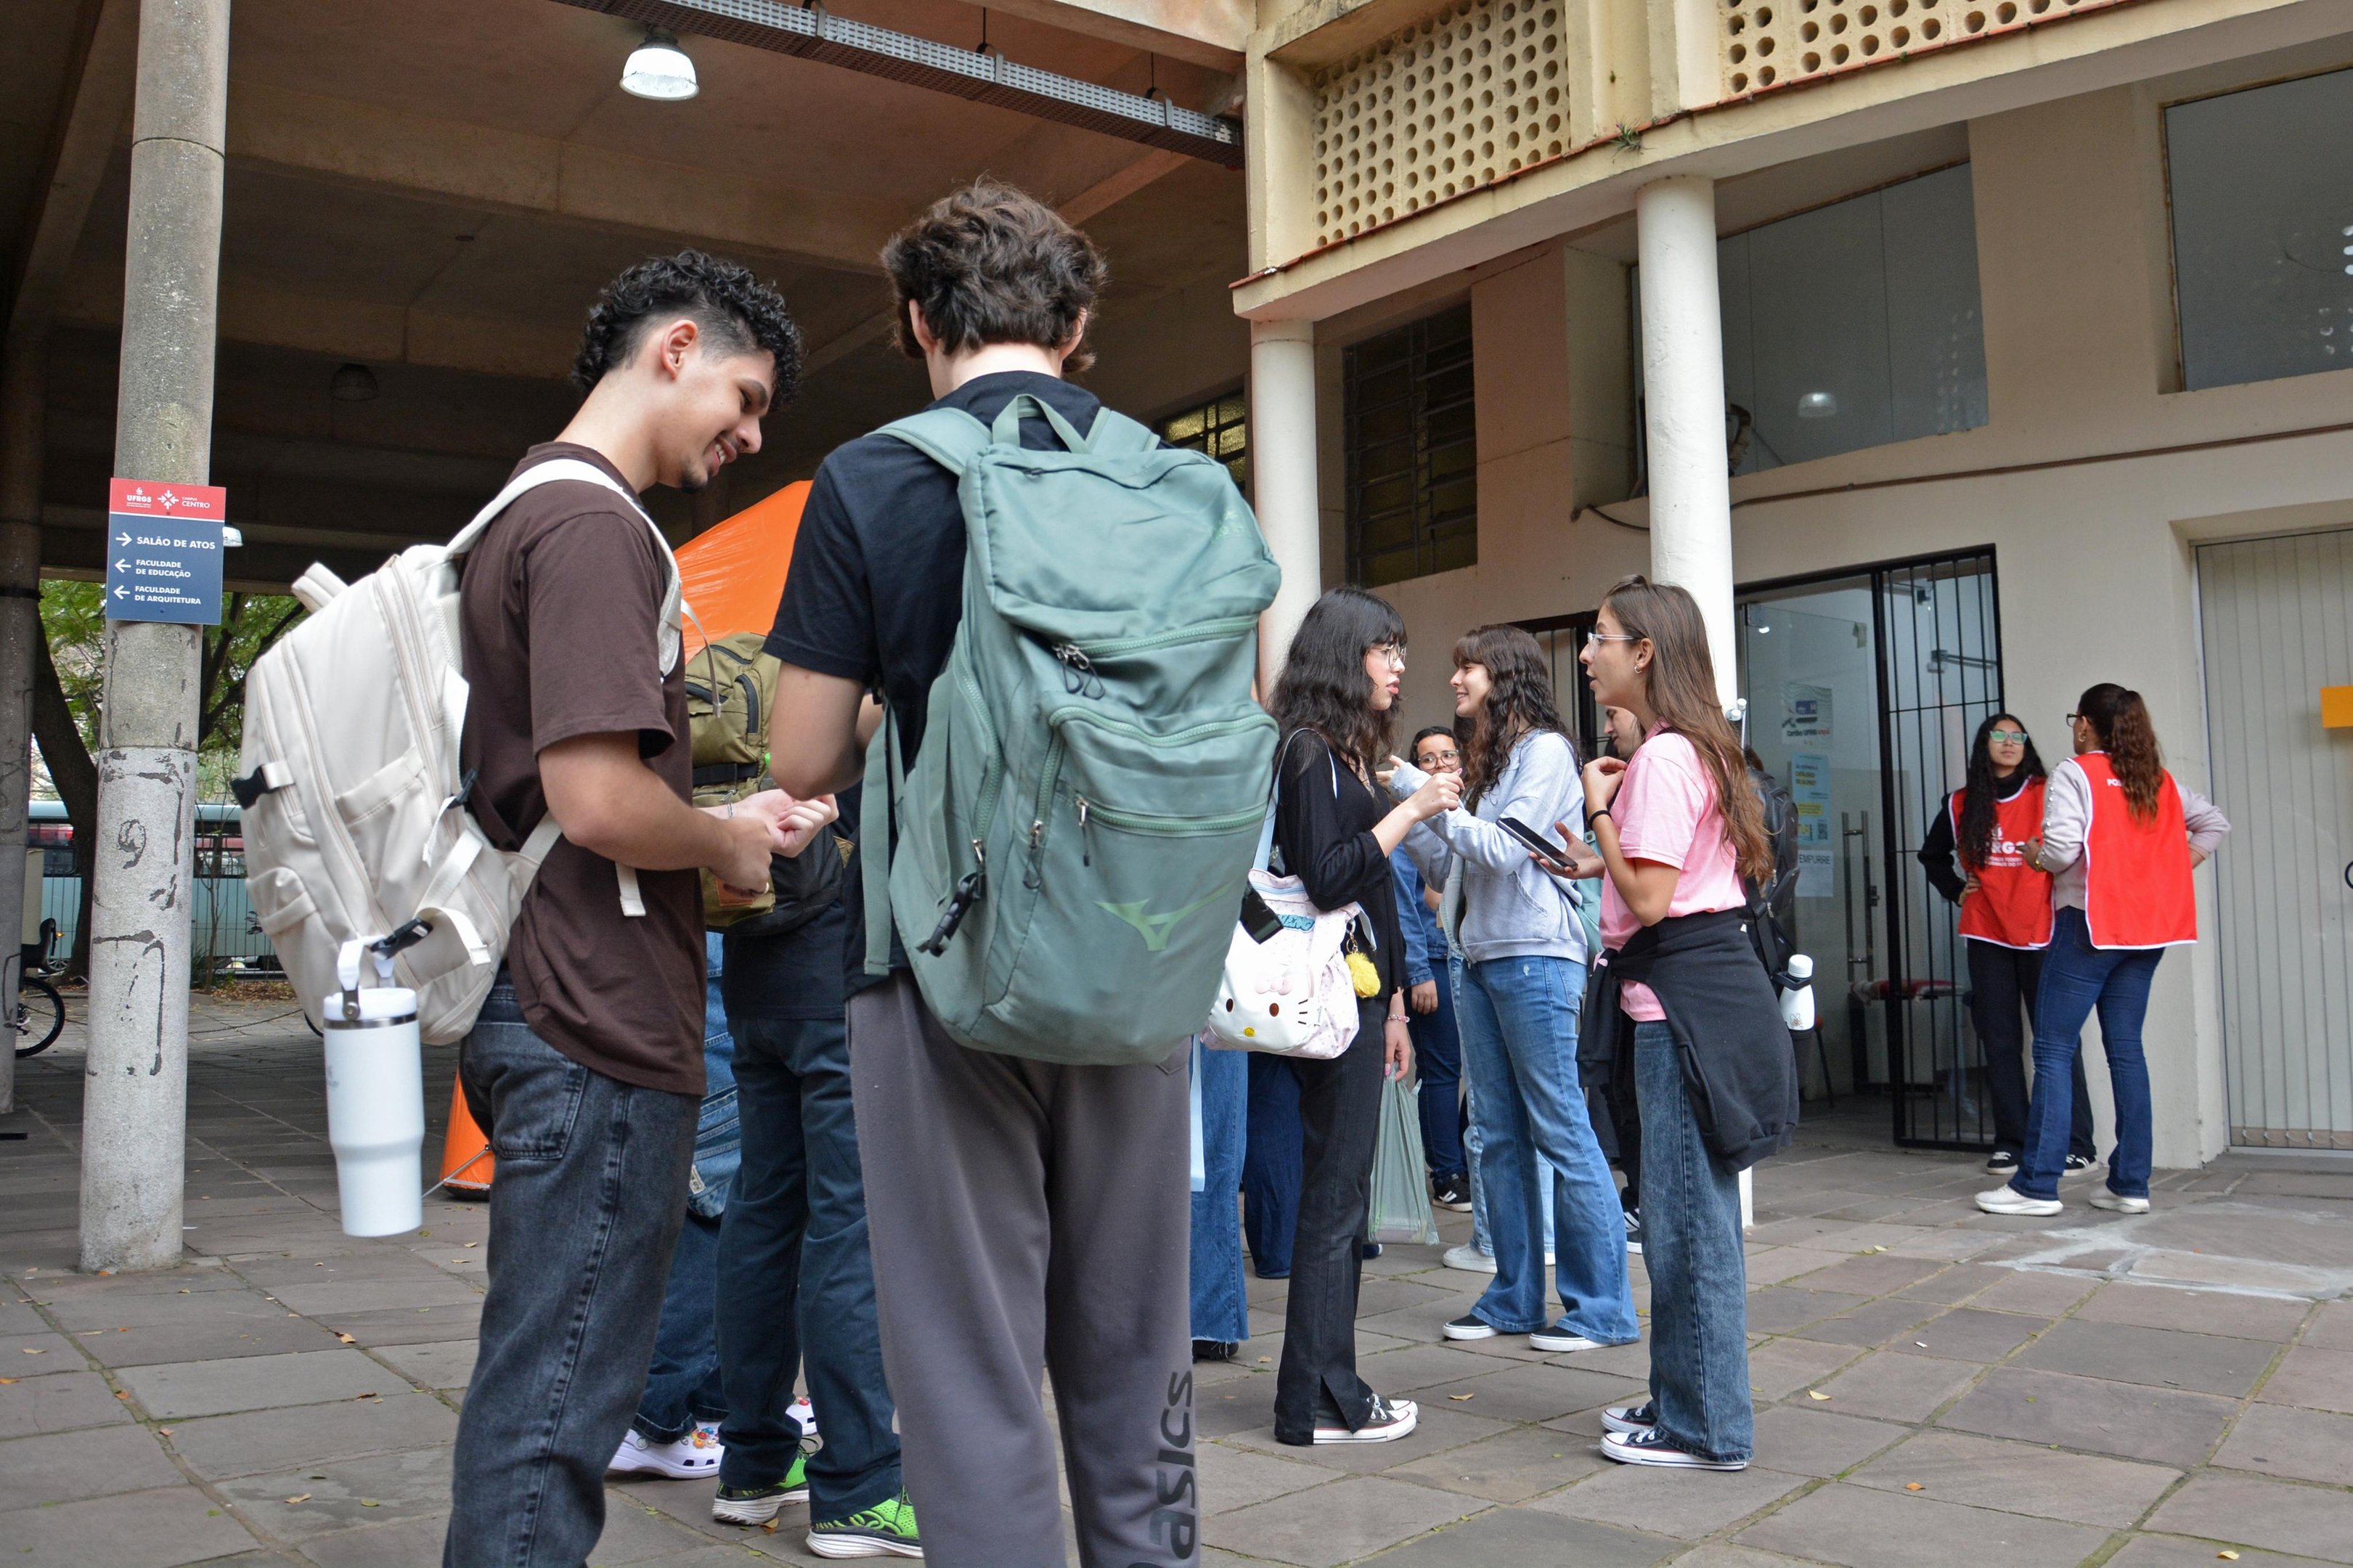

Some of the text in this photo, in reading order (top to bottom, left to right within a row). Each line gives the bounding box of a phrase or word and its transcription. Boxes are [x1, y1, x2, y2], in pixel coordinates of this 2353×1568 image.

[136, 536, 171, 546] SALÃO
[189, 540, 216, 550] ATOS
[136, 559, 182, 568] FACULDADE
[148, 569, 191, 579] EDUCAÇÃO
[147, 595, 201, 605] ARQUITETURA
[1799, 854, 1830, 865] EMPURRE
[1149, 1370, 1196, 1560] asics
